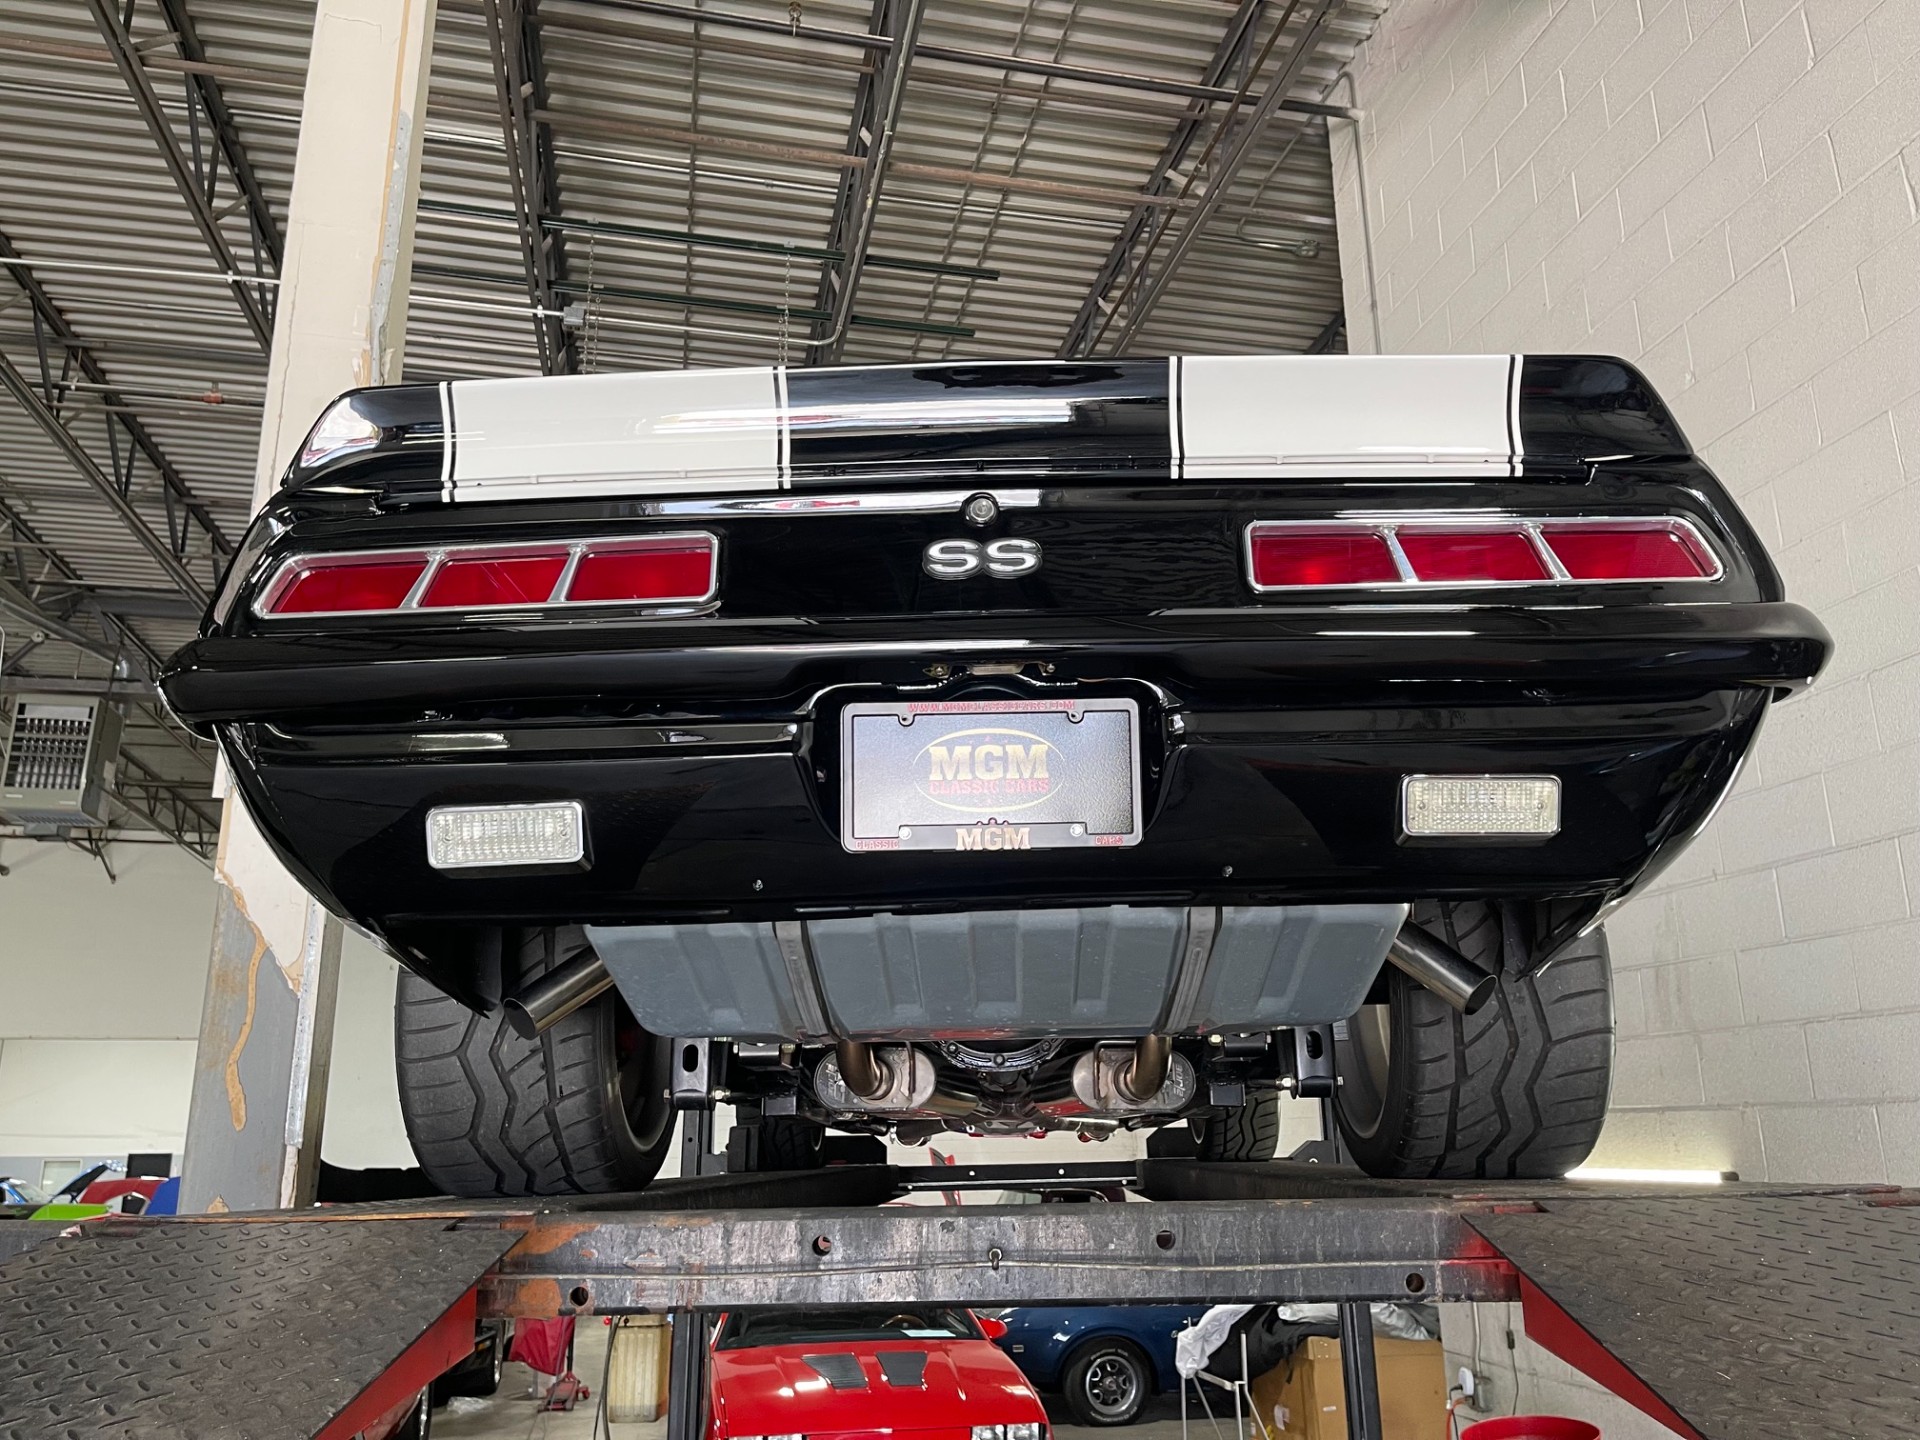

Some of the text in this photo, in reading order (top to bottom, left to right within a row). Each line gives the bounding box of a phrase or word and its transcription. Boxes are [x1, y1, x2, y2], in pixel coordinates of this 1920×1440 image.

[924, 538, 1041, 579] SS
[929, 744, 1049, 780] MGM
[929, 778, 1050, 795] CLASSIC CARS
[855, 840, 899, 850] CLASSIC
[955, 827, 1031, 850] MGM
[1095, 835, 1124, 845] CARS
